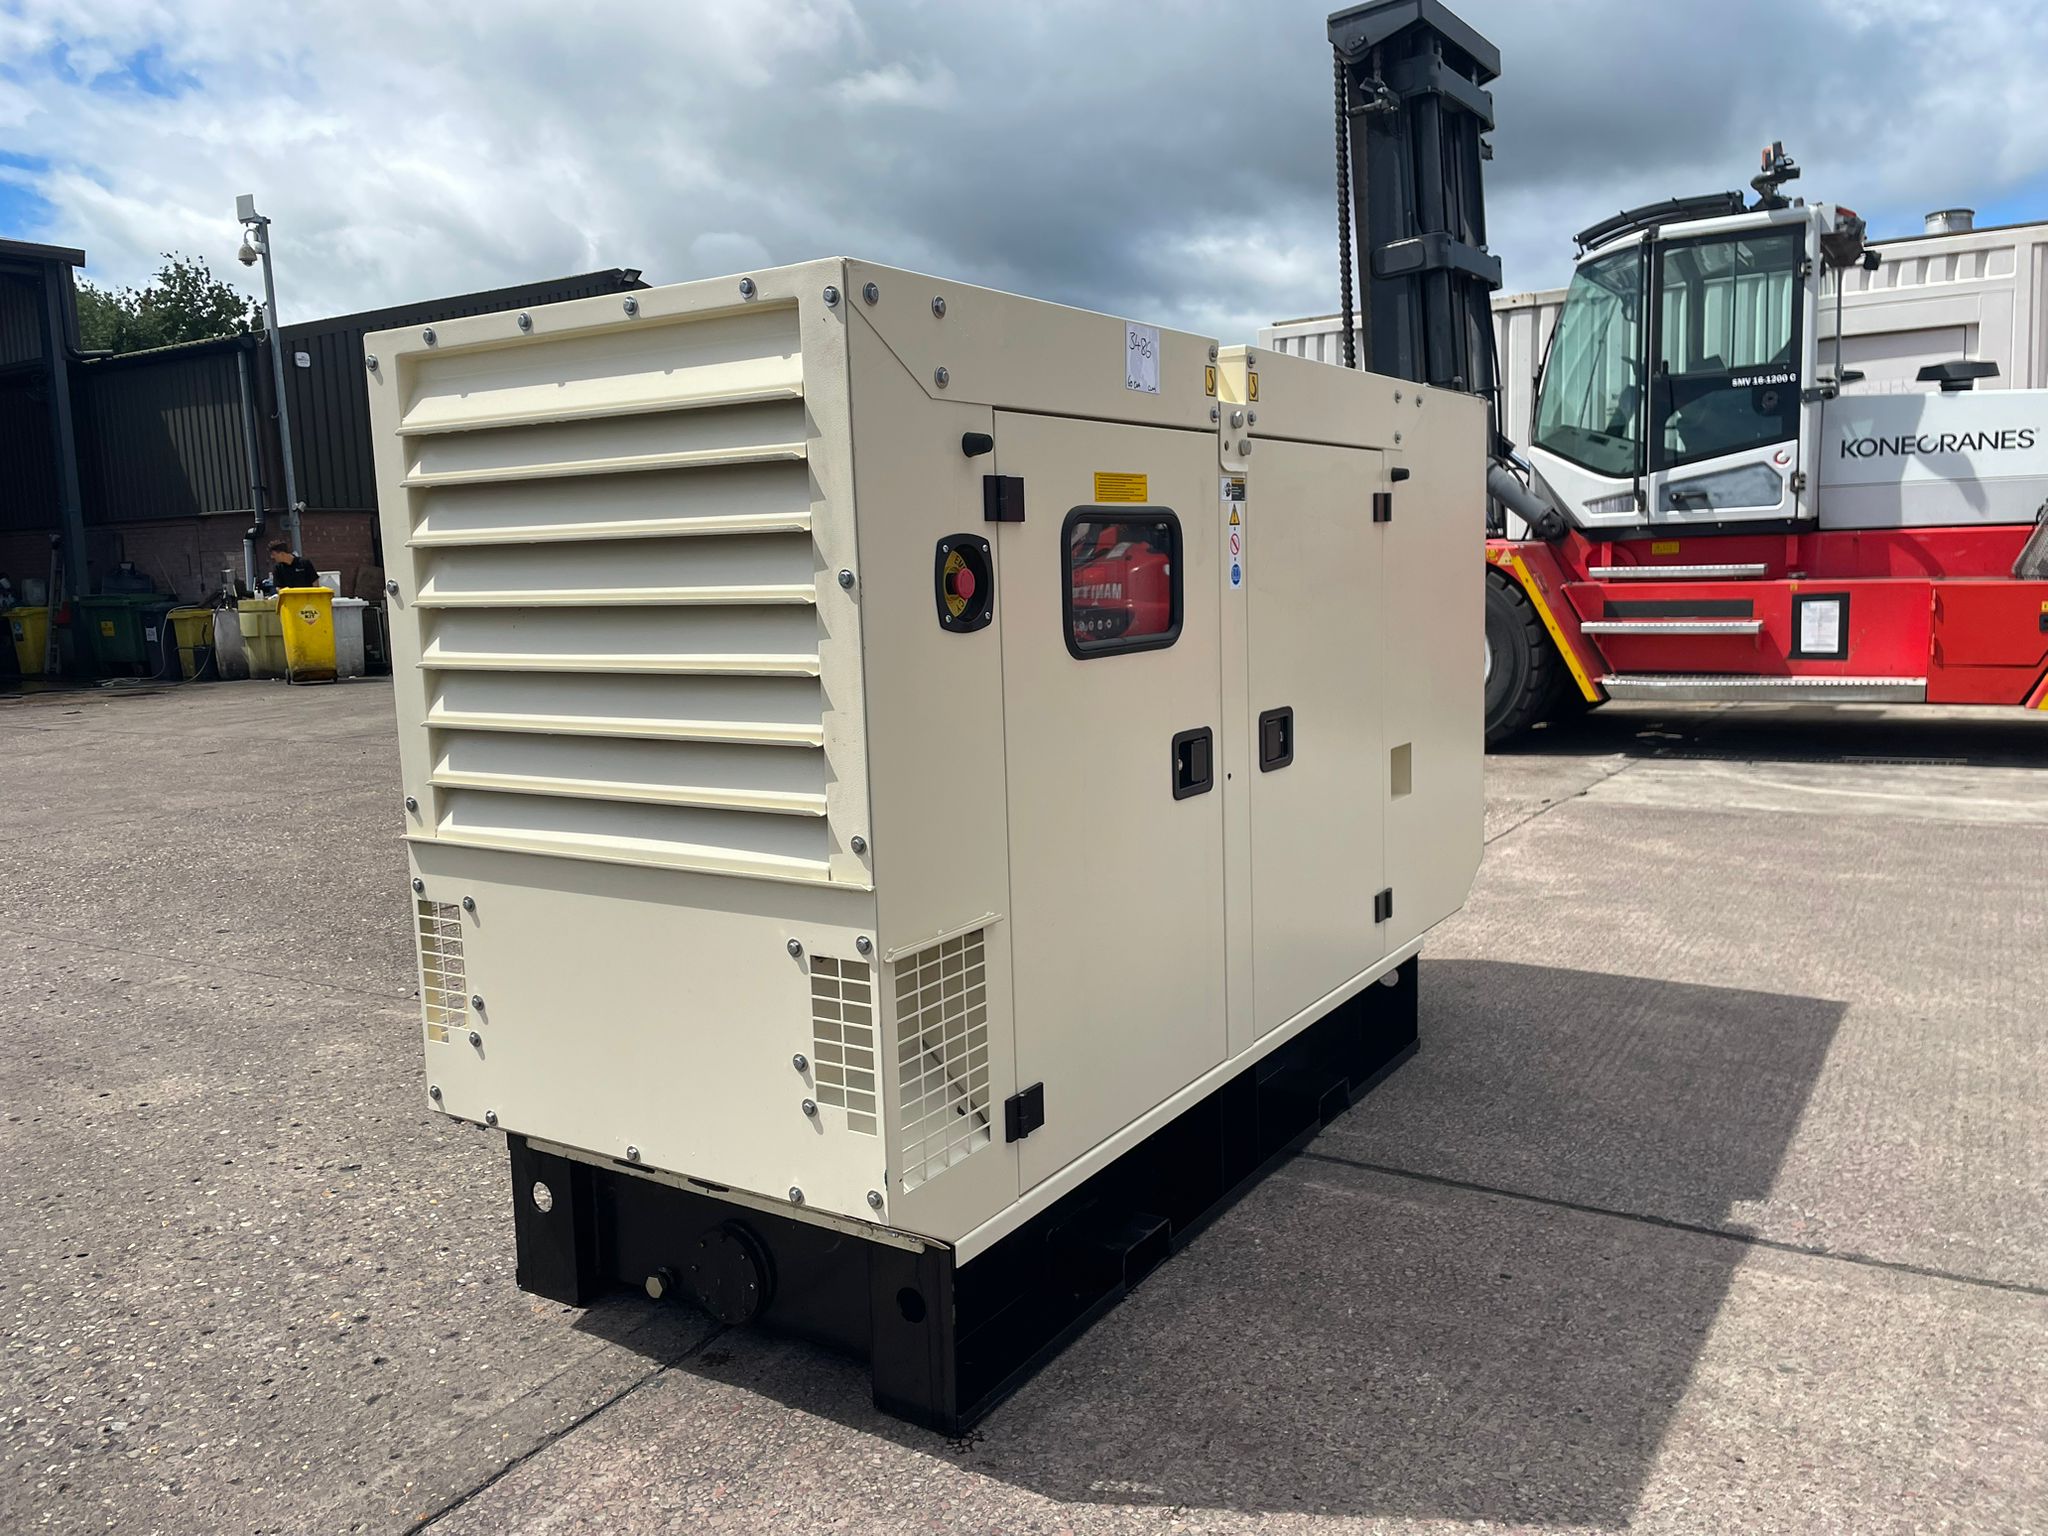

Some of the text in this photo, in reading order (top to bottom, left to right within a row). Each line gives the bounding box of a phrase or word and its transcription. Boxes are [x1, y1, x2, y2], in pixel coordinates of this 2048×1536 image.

[1129, 331, 1152, 359] 3486
[1732, 377, 1751, 388] SMV
[1752, 373, 1788, 386] 16-1200
[1840, 428, 2035, 459] KONECRANES
